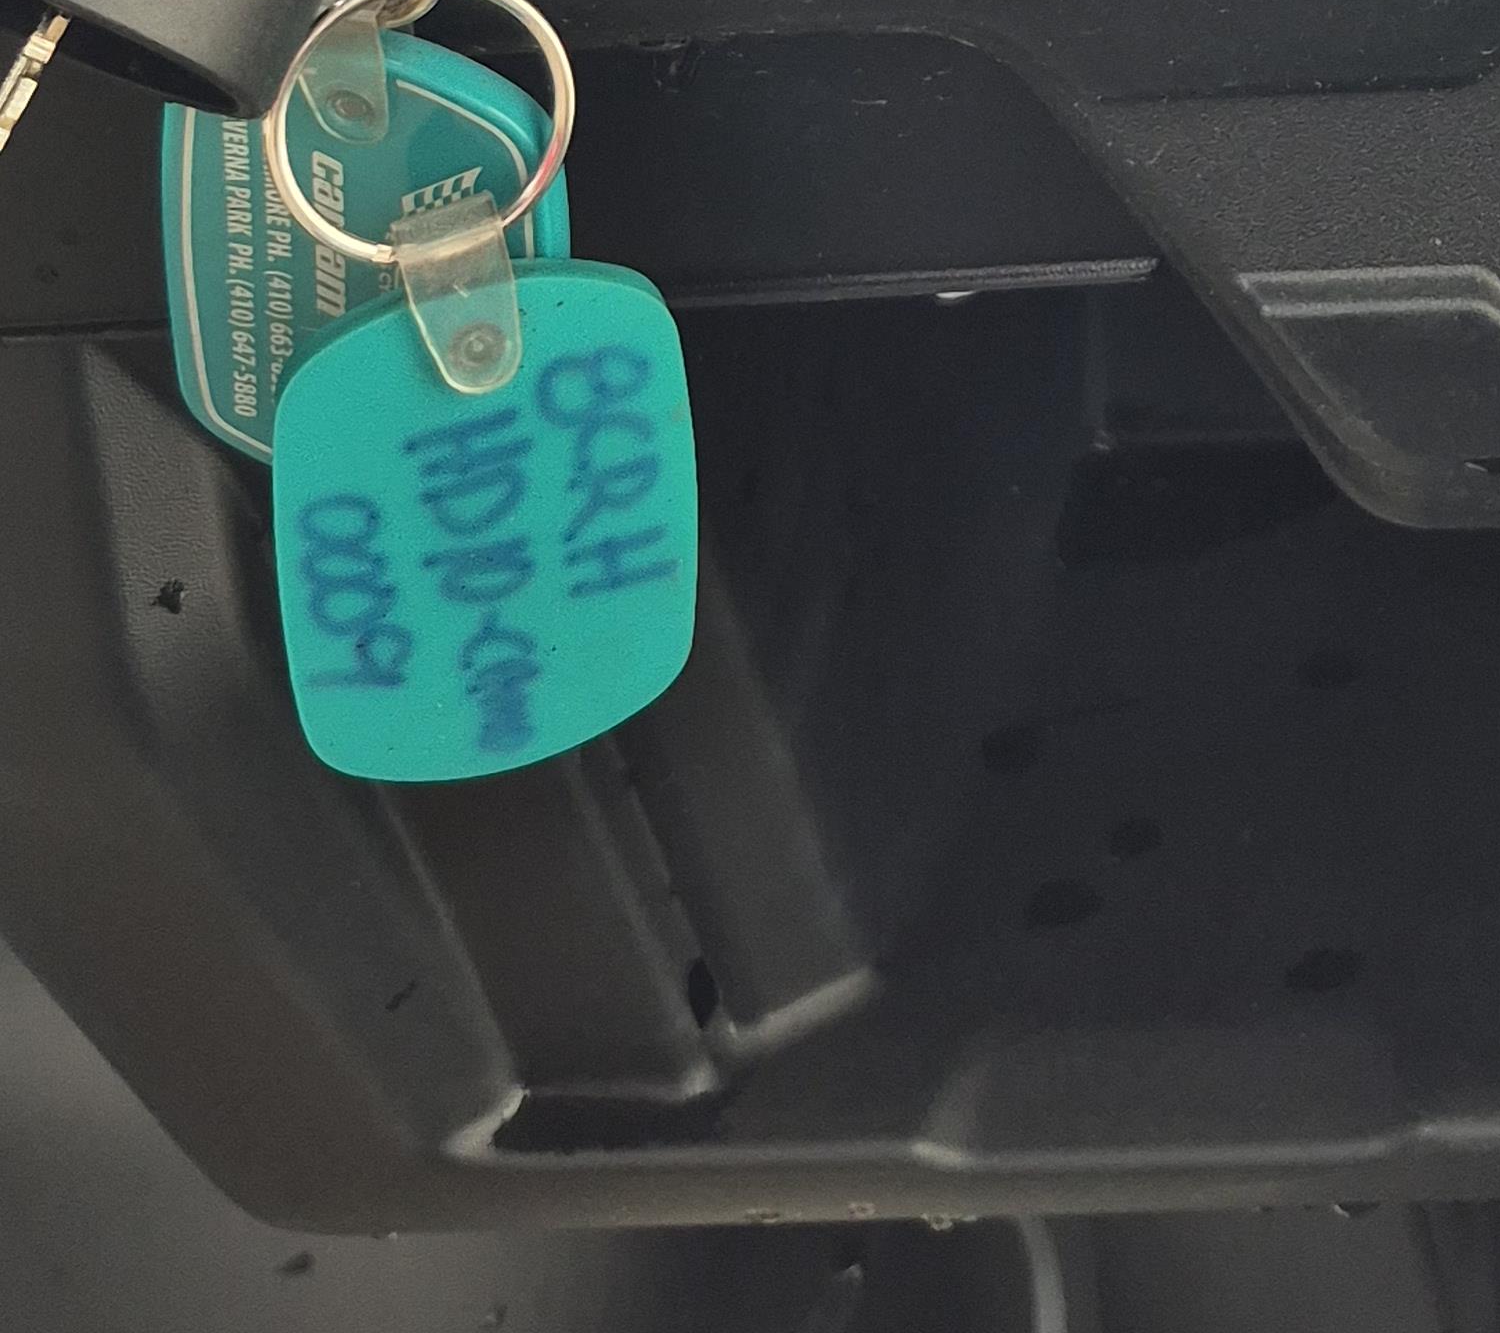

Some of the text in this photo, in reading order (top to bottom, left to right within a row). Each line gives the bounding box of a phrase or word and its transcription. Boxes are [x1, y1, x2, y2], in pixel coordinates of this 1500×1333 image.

[222, 117, 258, 418] VERNA PARK PH. (410) 647-5880
[267, 230, 292, 262] PH.
[264, 271, 293, 321] (410)
